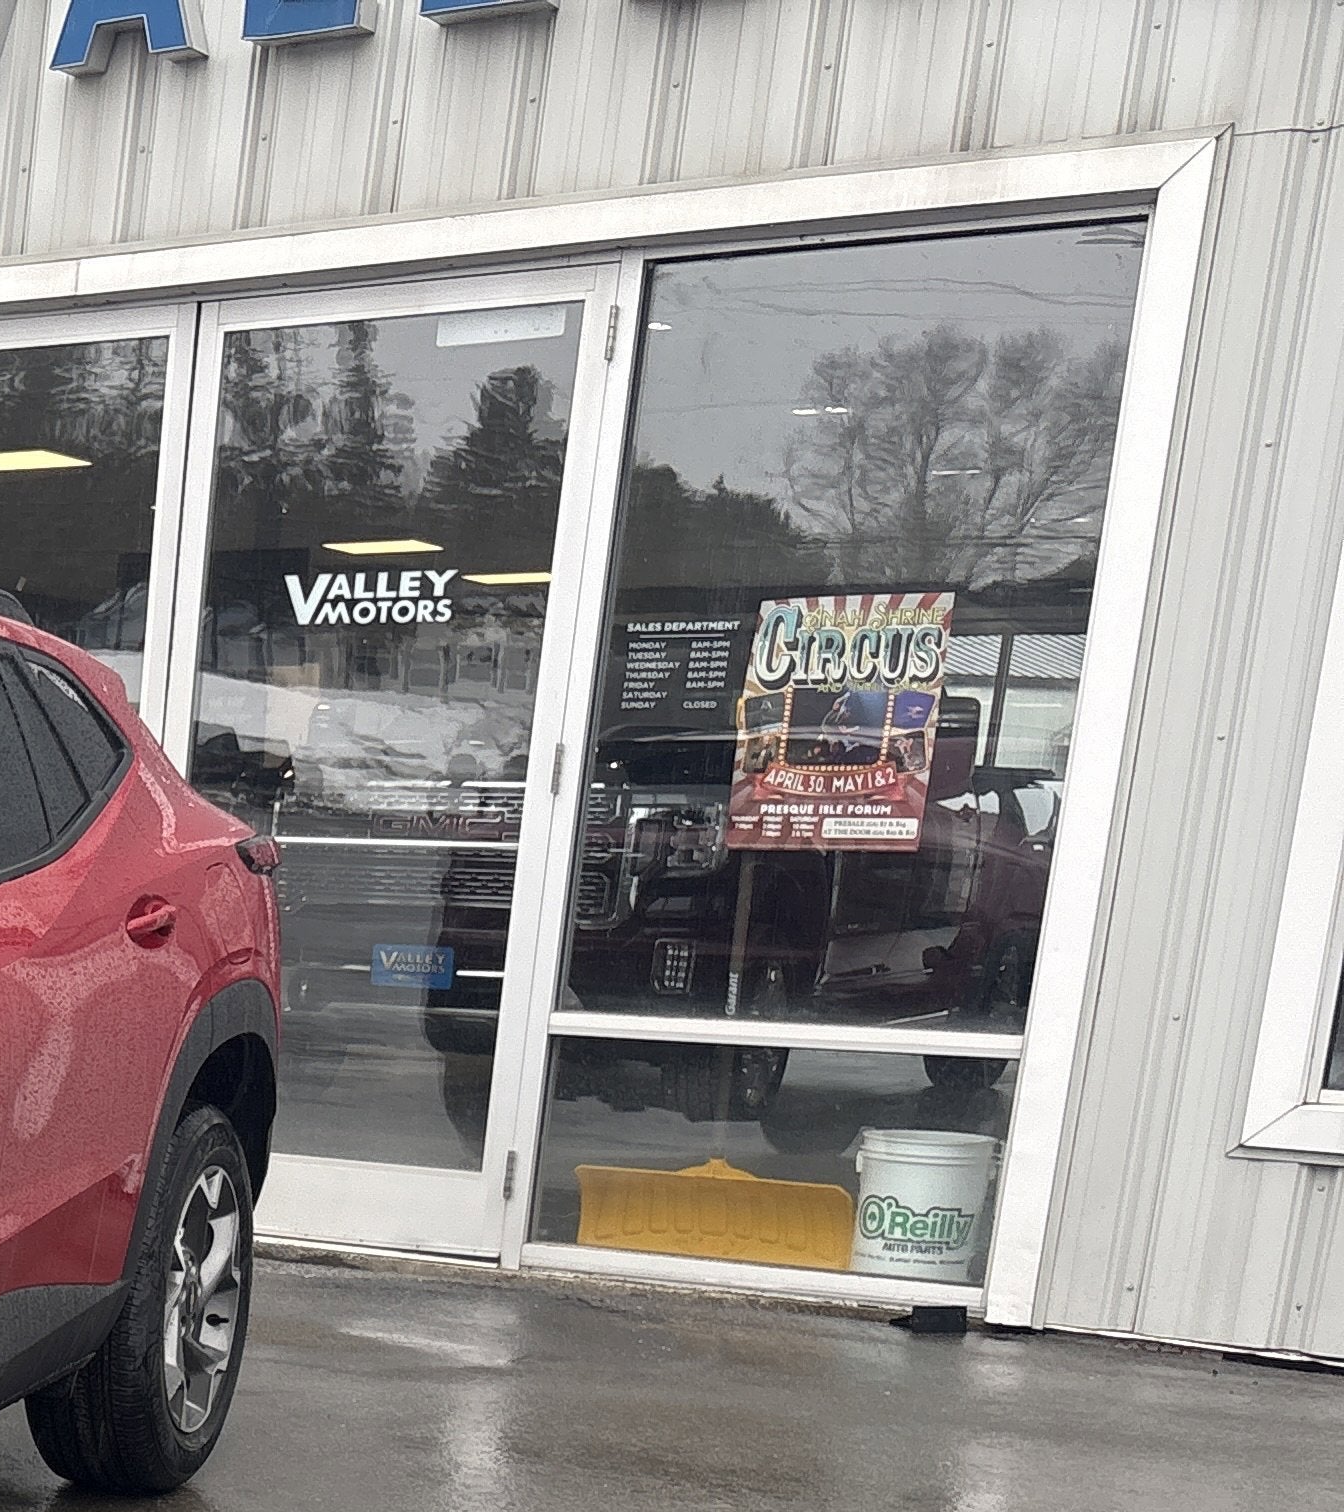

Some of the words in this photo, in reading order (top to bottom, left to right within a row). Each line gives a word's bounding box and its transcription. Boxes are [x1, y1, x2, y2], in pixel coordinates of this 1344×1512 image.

[284, 569, 459, 625] VALLEY
[314, 599, 453, 625] MOTORS
[802, 606, 866, 636] ANAH
[870, 602, 946, 630] SHRINE
[627, 622, 662, 632] SALES
[664, 621, 740, 631] DEPARTMENT
[628, 641, 666, 650] MONDAY
[753, 604, 944, 691] CIRCUS
[628, 651, 667, 660] TUESDAY
[626, 661, 681, 670] WEDNESDAY
[625, 671, 671, 680] THURSDAY
[623, 681, 656, 690] FRIDAY
[622, 691, 668, 700] SATURDAY
[621, 701, 656, 710] SUNDAY
[683, 701, 717, 709] CLOSED
[764, 768, 805, 792] APRIL
[831, 773, 864, 792] MAY
[874, 770, 886, 787] &
[885, 767, 896, 784] 2
[760, 804, 814, 814] PRESQUE
[818, 804, 844, 814] ISLE
[847, 804, 892, 815] FORUM
[380, 950, 446, 971] VALLEY
[861, 1197, 974, 1248] O'Reilly
[882, 1242, 909, 1254] AUTO
[909, 1244, 944, 1255] PARTS
